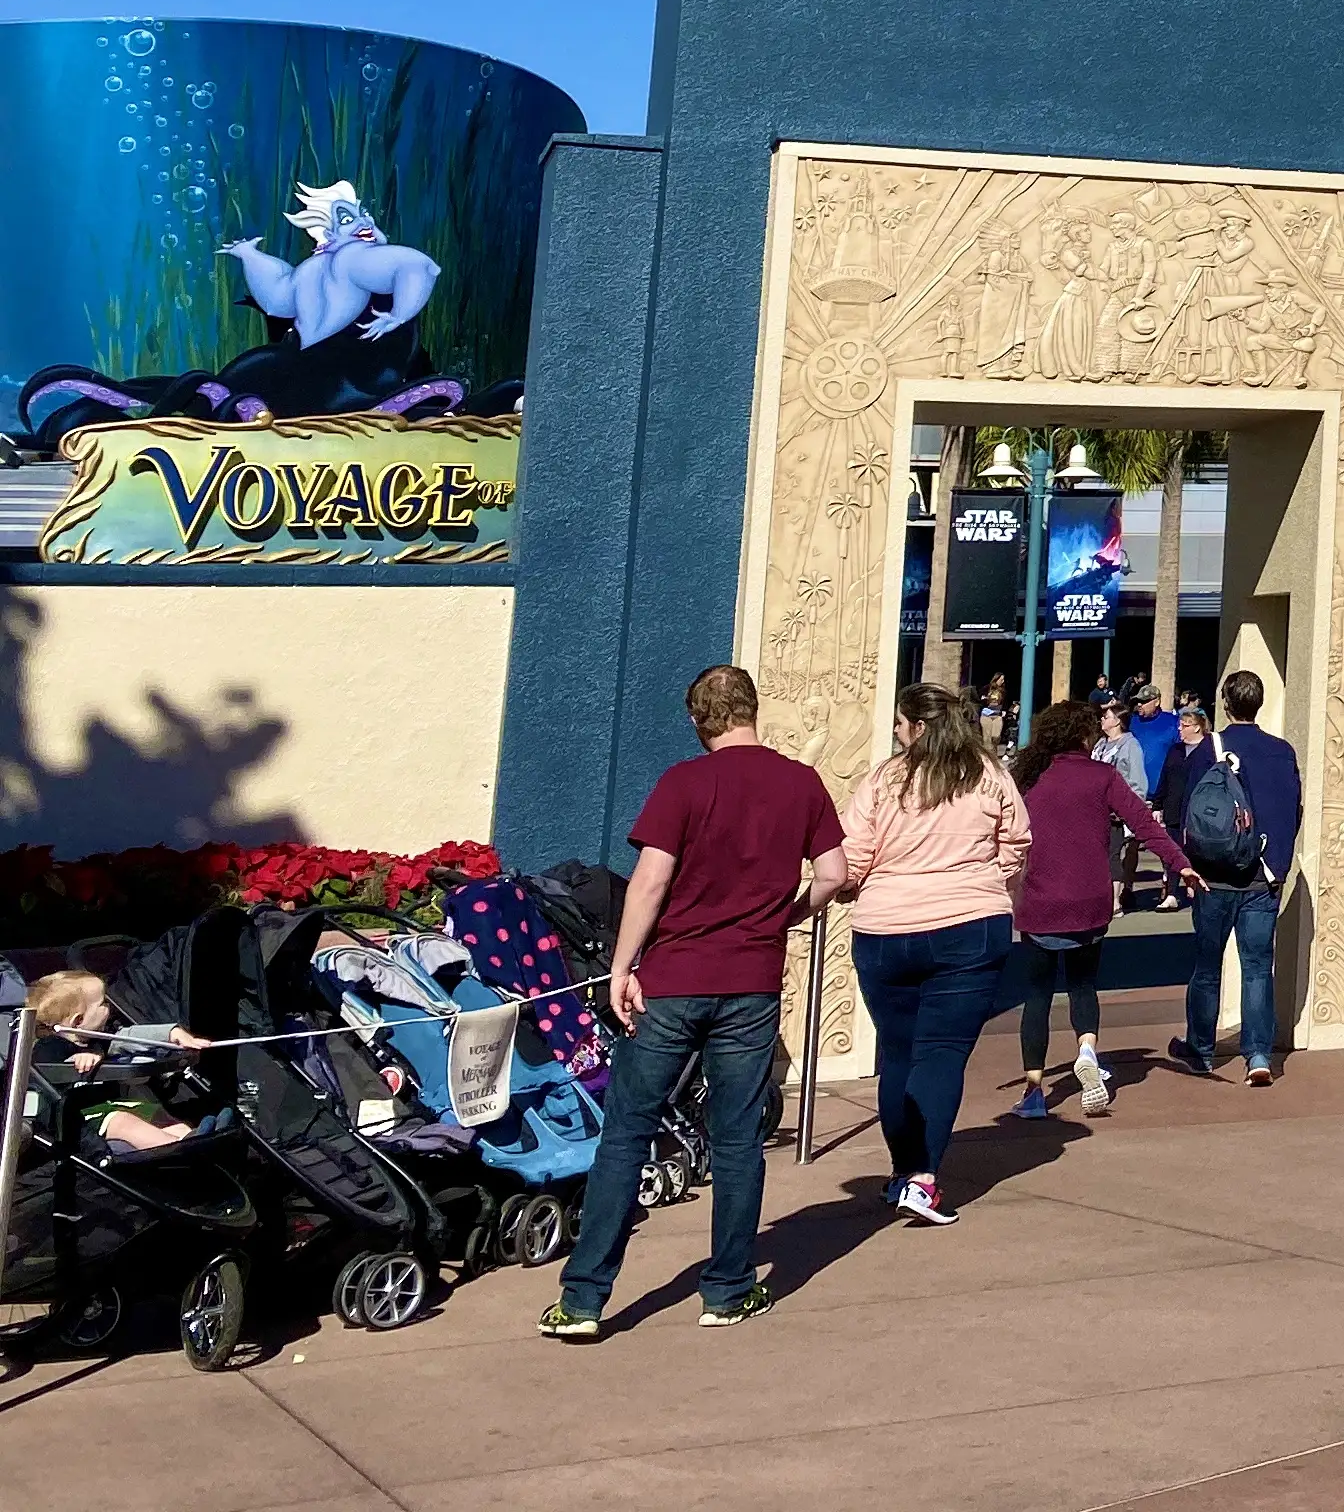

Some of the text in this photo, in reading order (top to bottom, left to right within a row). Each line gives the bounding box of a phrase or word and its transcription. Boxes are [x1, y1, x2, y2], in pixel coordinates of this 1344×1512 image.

[129, 442, 516, 546] VOYAGE OF
[955, 509, 1018, 524] STAR
[955, 527, 1017, 542] WARS
[1056, 594, 1108, 607] STAR
[1056, 609, 1107, 622] WARS
[457, 1084, 498, 1105] STROLLER
